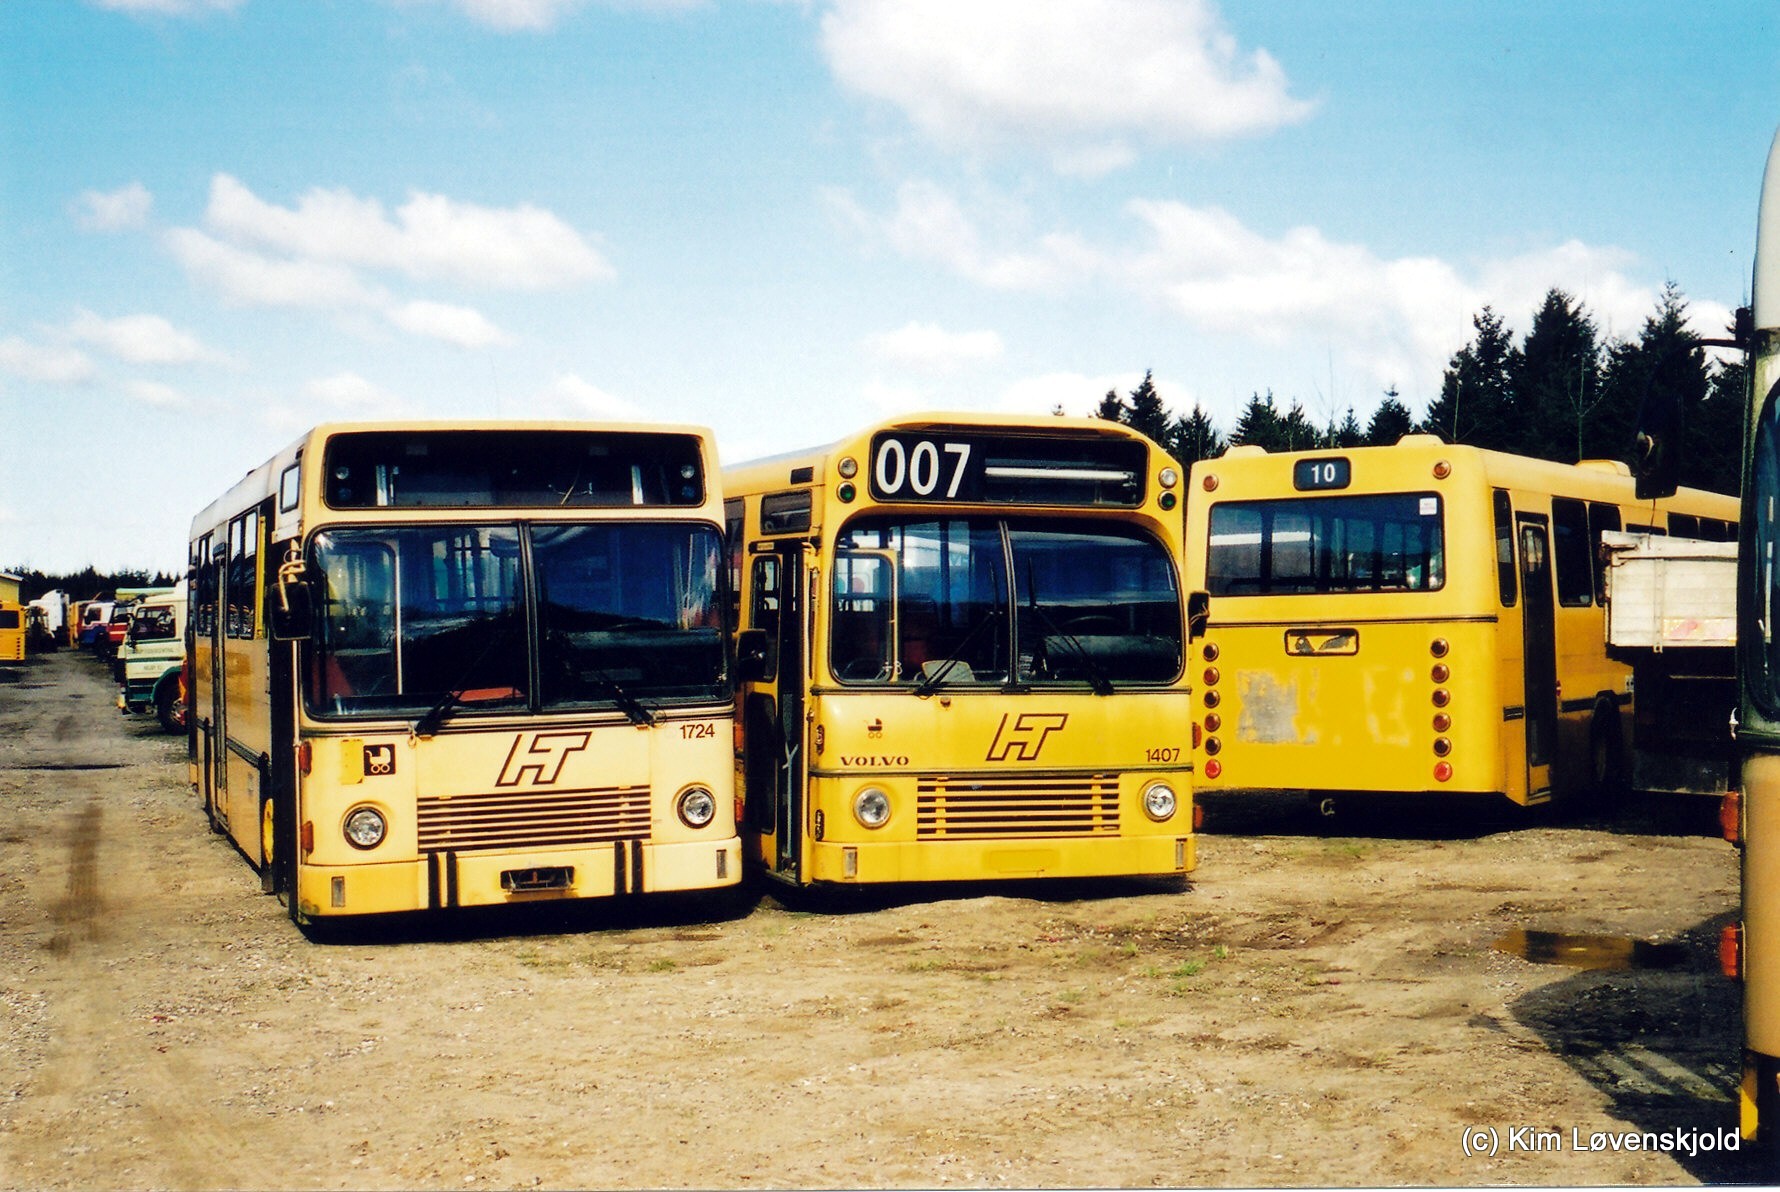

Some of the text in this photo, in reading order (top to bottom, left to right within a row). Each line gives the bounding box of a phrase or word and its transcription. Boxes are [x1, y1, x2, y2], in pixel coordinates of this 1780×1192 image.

[875, 438, 971, 498] 007
[1311, 462, 1336, 484] 10
[680, 722, 716, 740] 1724
[986, 713, 1069, 761] HT
[494, 731, 593, 787] HT
[840, 755, 910, 766] VOLVO
[1145, 748, 1181, 763] 1407
